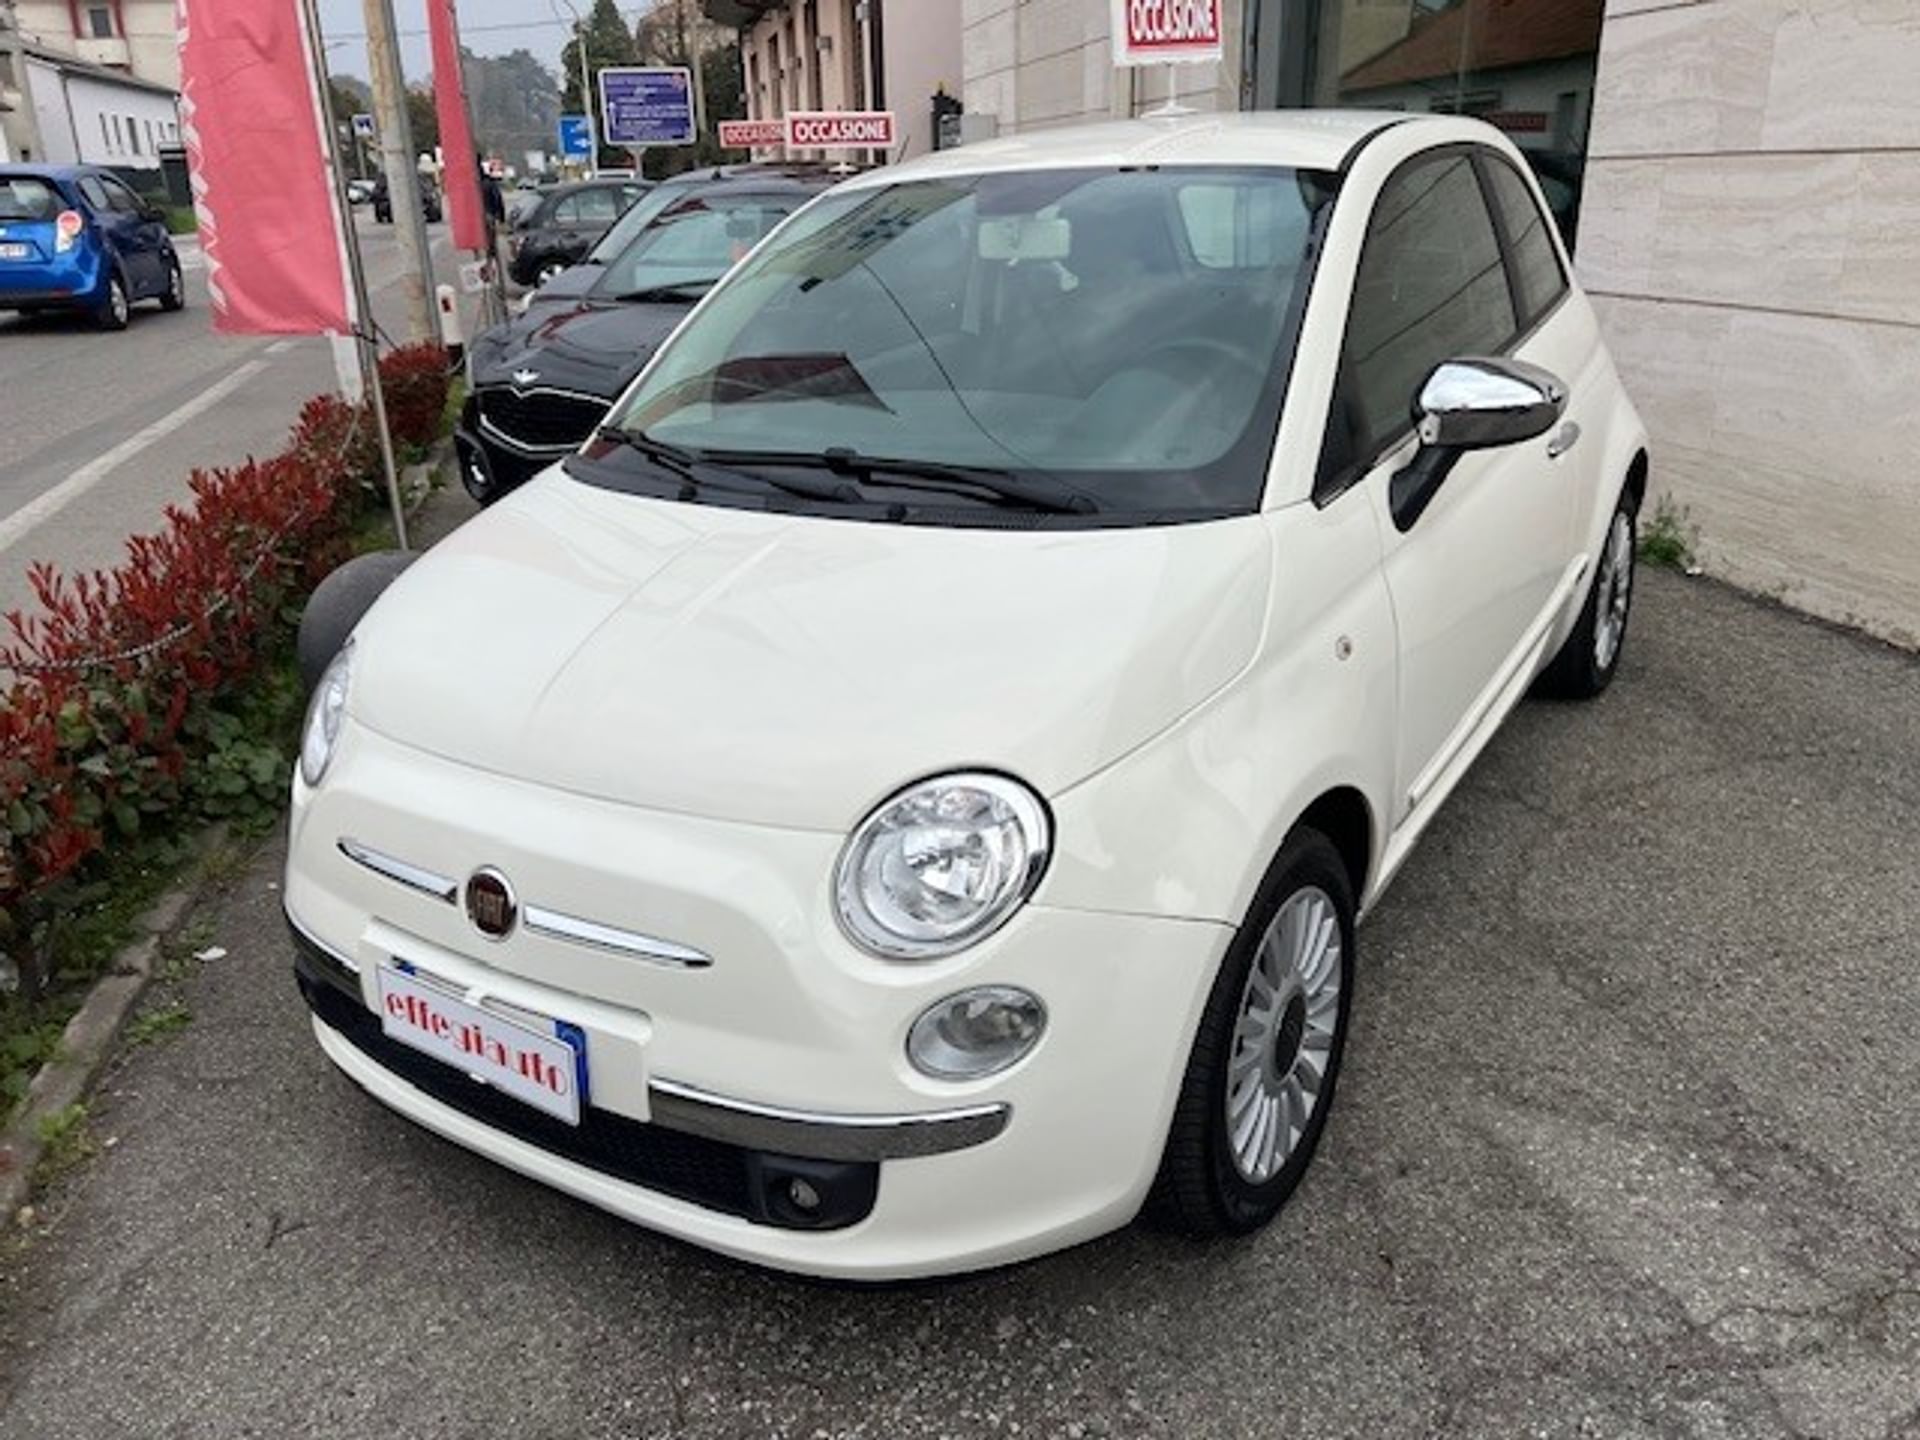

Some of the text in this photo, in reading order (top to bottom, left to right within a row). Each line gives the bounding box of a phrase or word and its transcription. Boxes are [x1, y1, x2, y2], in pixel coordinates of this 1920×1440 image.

[1131, 0, 1216, 41] OCCASIONE
[725, 125, 785, 142] OCCASION
[795, 119, 887, 141] OCCASIONE
[386, 991, 568, 1097] effegiauto
